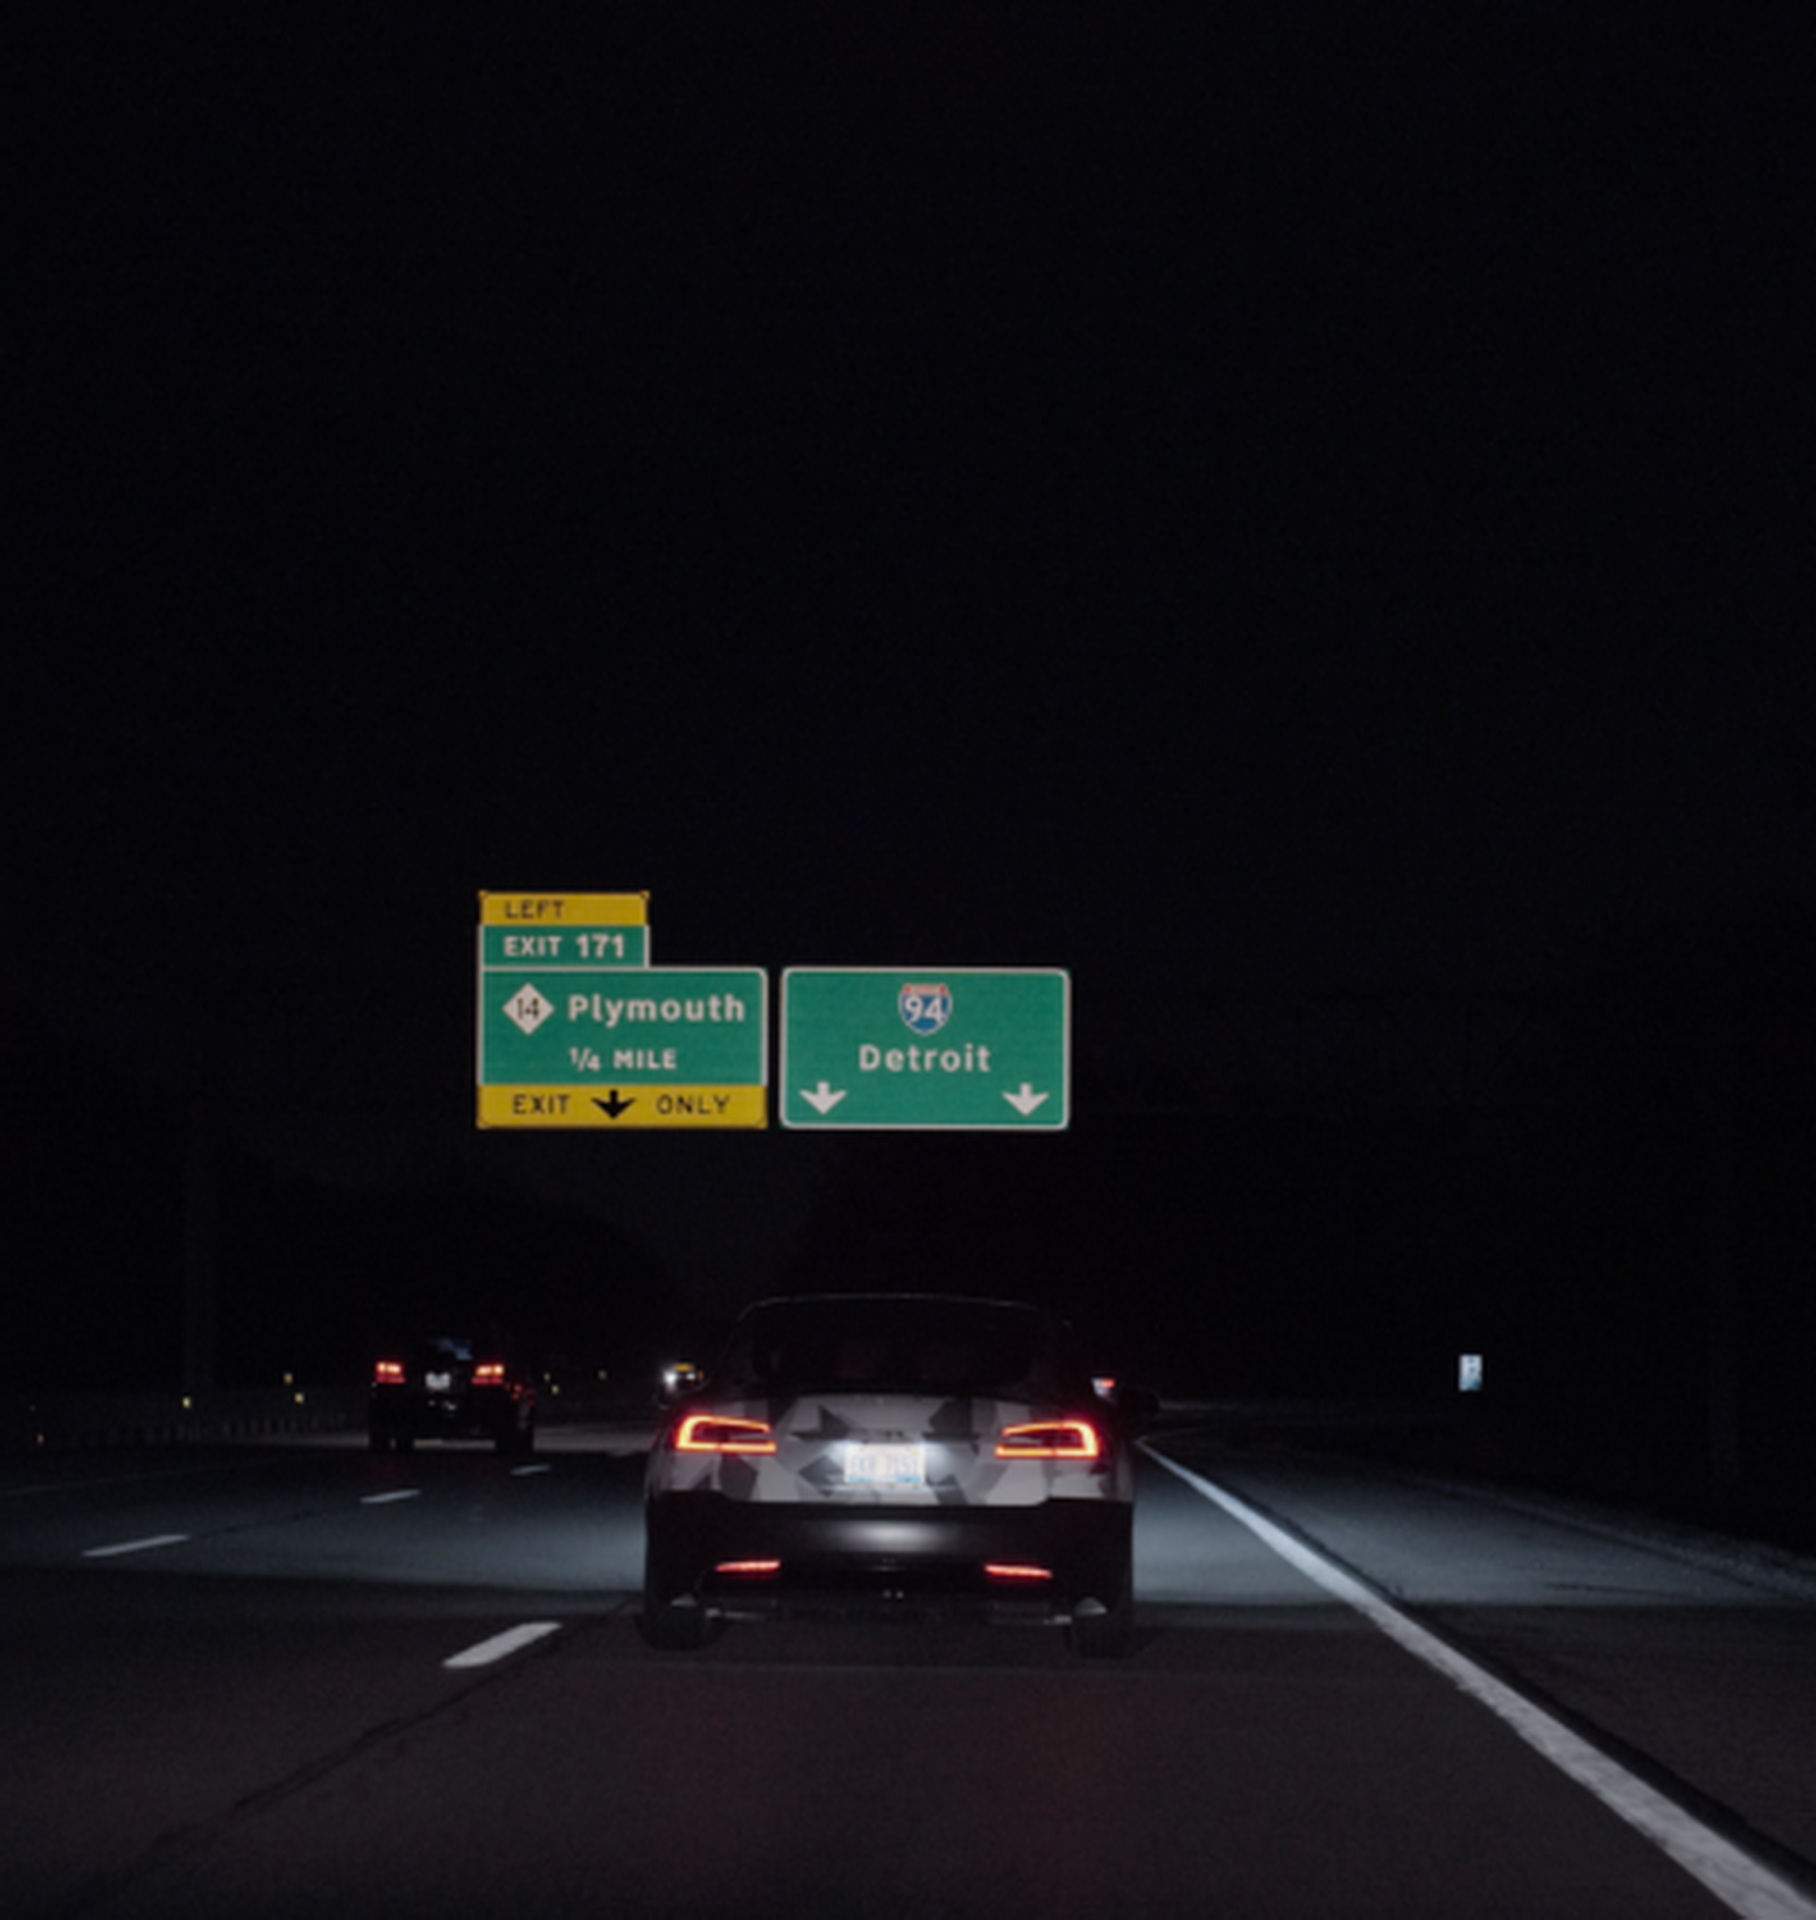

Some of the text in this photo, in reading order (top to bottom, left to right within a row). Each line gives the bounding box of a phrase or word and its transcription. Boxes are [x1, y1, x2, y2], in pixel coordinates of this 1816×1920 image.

[505, 901, 564, 918] LEFT
[504, 934, 624, 958] EXIT 171
[516, 994, 744, 1028] 14 Plymouth
[905, 995, 943, 1023] 94
[613, 1050, 676, 1069] MILE
[858, 1044, 990, 1072] Detroit
[513, 1095, 731, 1114] EXIT ONLY
